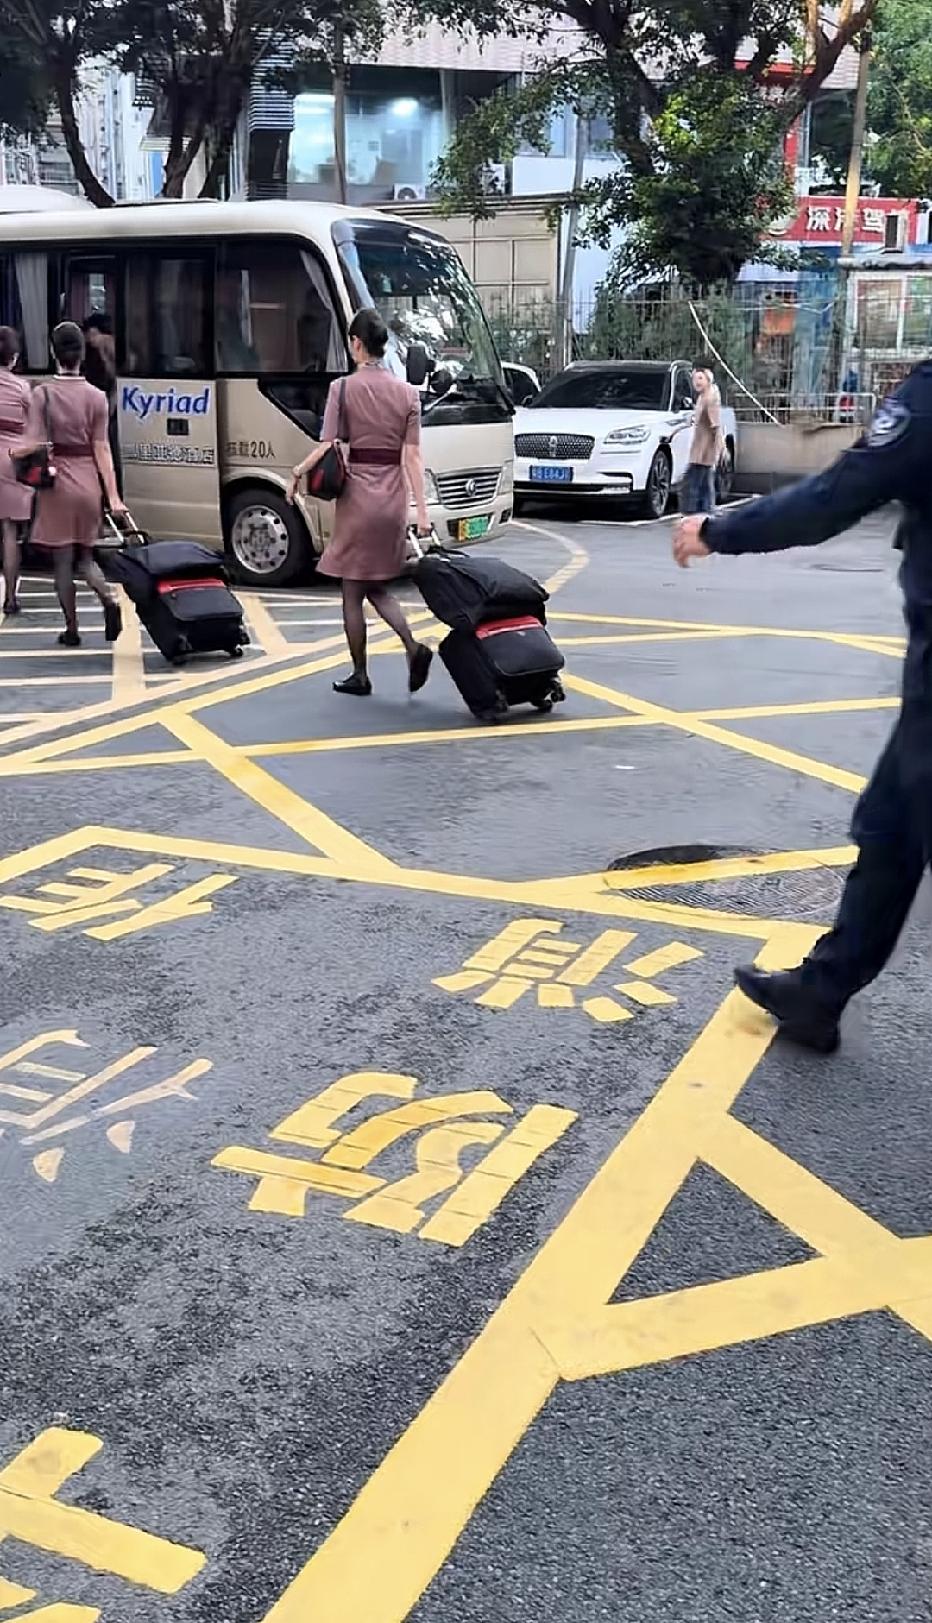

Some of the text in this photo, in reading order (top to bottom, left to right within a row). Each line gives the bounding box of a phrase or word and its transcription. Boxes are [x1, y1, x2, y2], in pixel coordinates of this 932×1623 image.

[122, 386, 211, 419] Kyriad
[431, 918, 706, 1023] 消
[211, 1072, 578, 1248] 防
